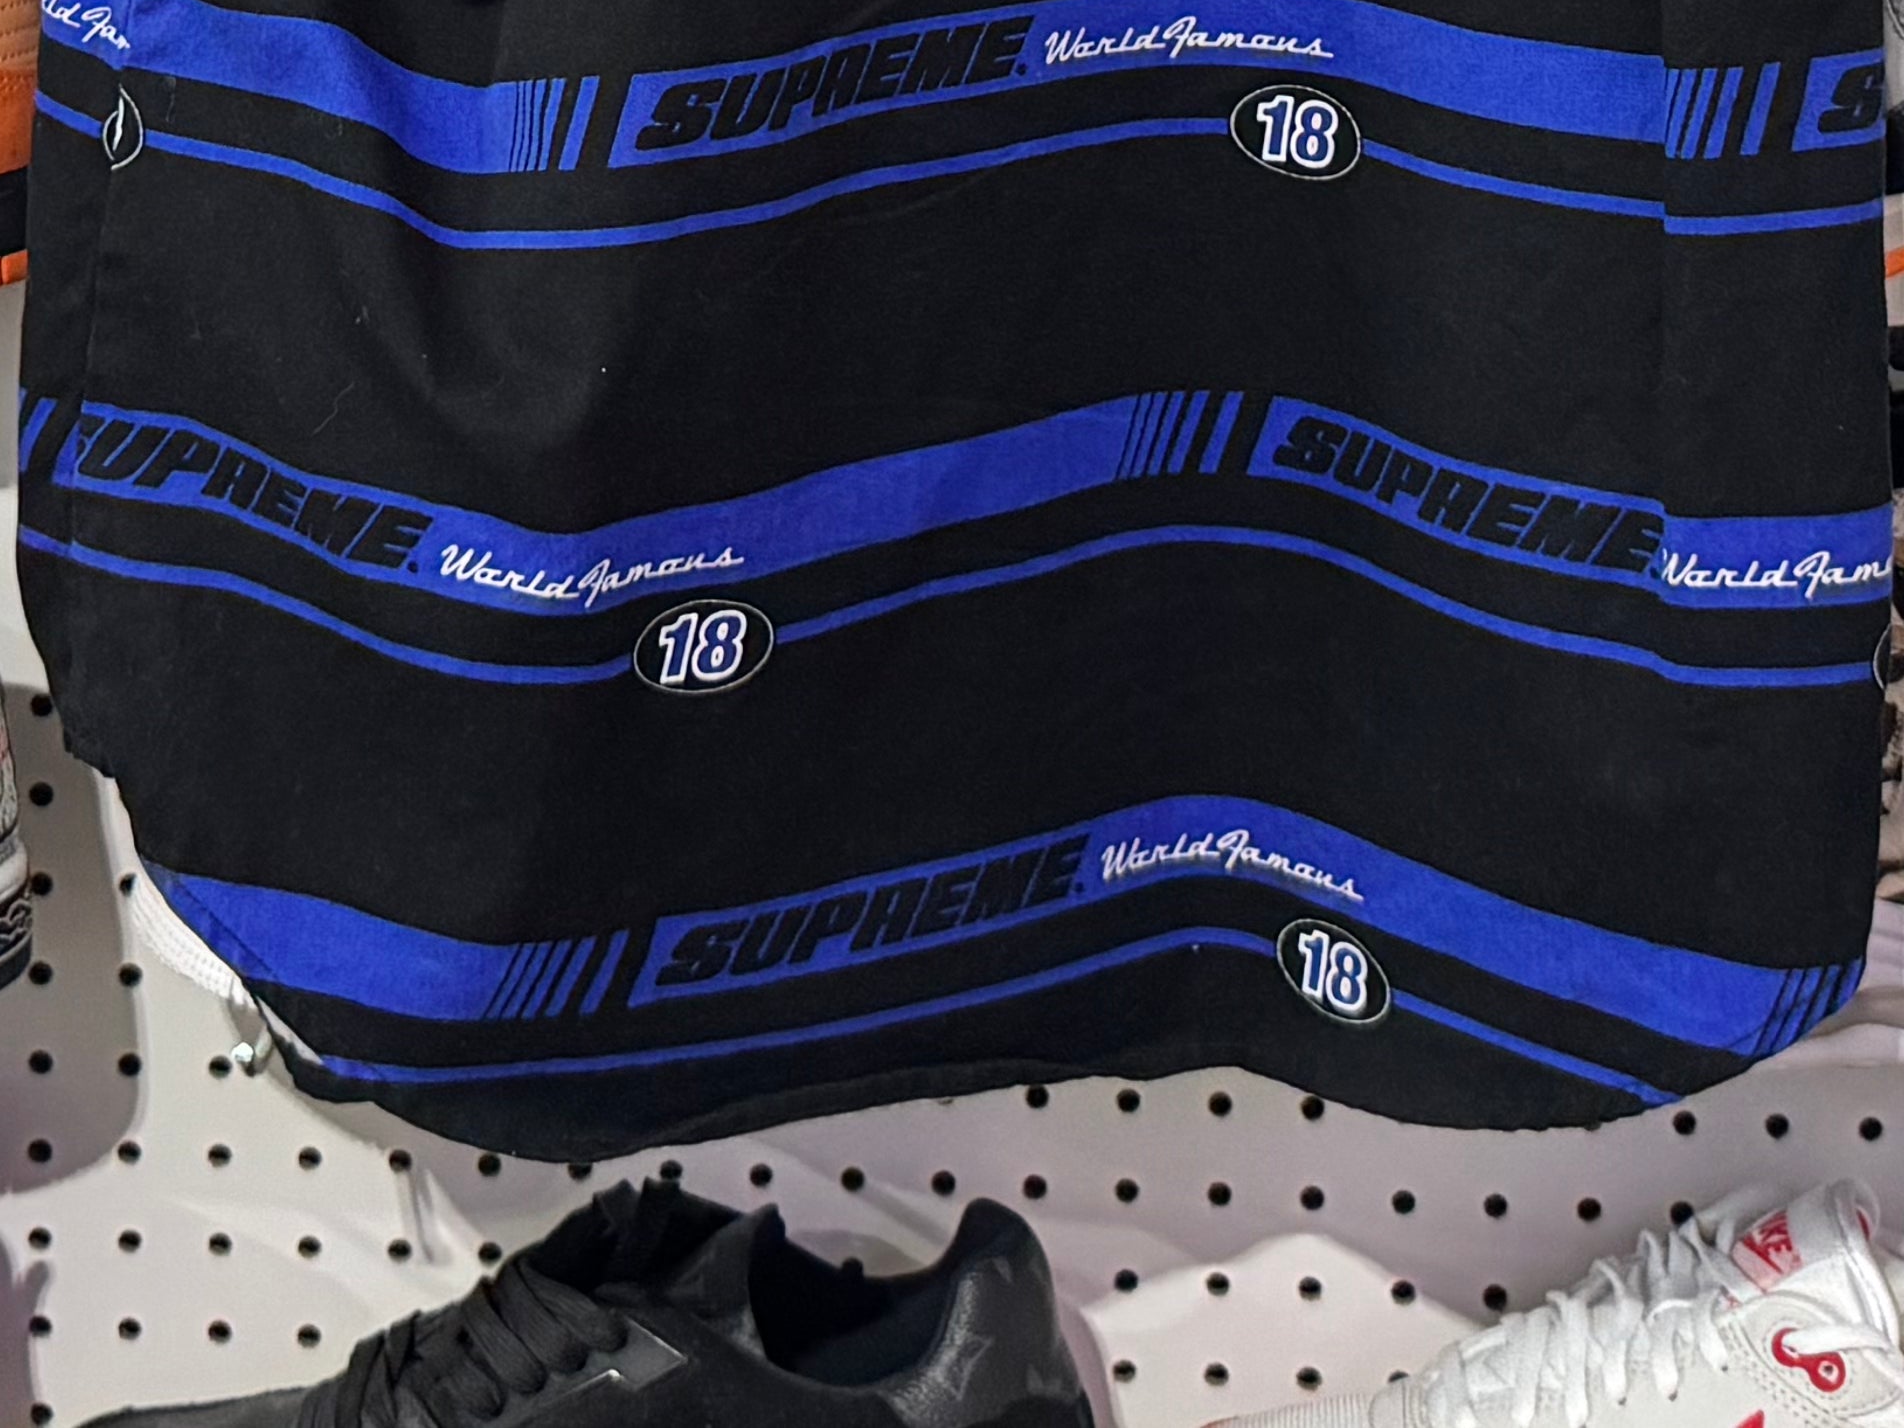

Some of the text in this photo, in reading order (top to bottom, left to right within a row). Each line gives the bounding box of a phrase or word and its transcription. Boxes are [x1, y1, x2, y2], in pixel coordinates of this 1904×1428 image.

[1045, 25, 1171, 64] World
[1165, 17, 1334, 59] Famous
[1257, 95, 1339, 168] 18
[440, 543, 580, 598] World
[658, 611, 749, 684] 18
[1101, 833, 1221, 882] World
[1298, 929, 1369, 1012] 18
